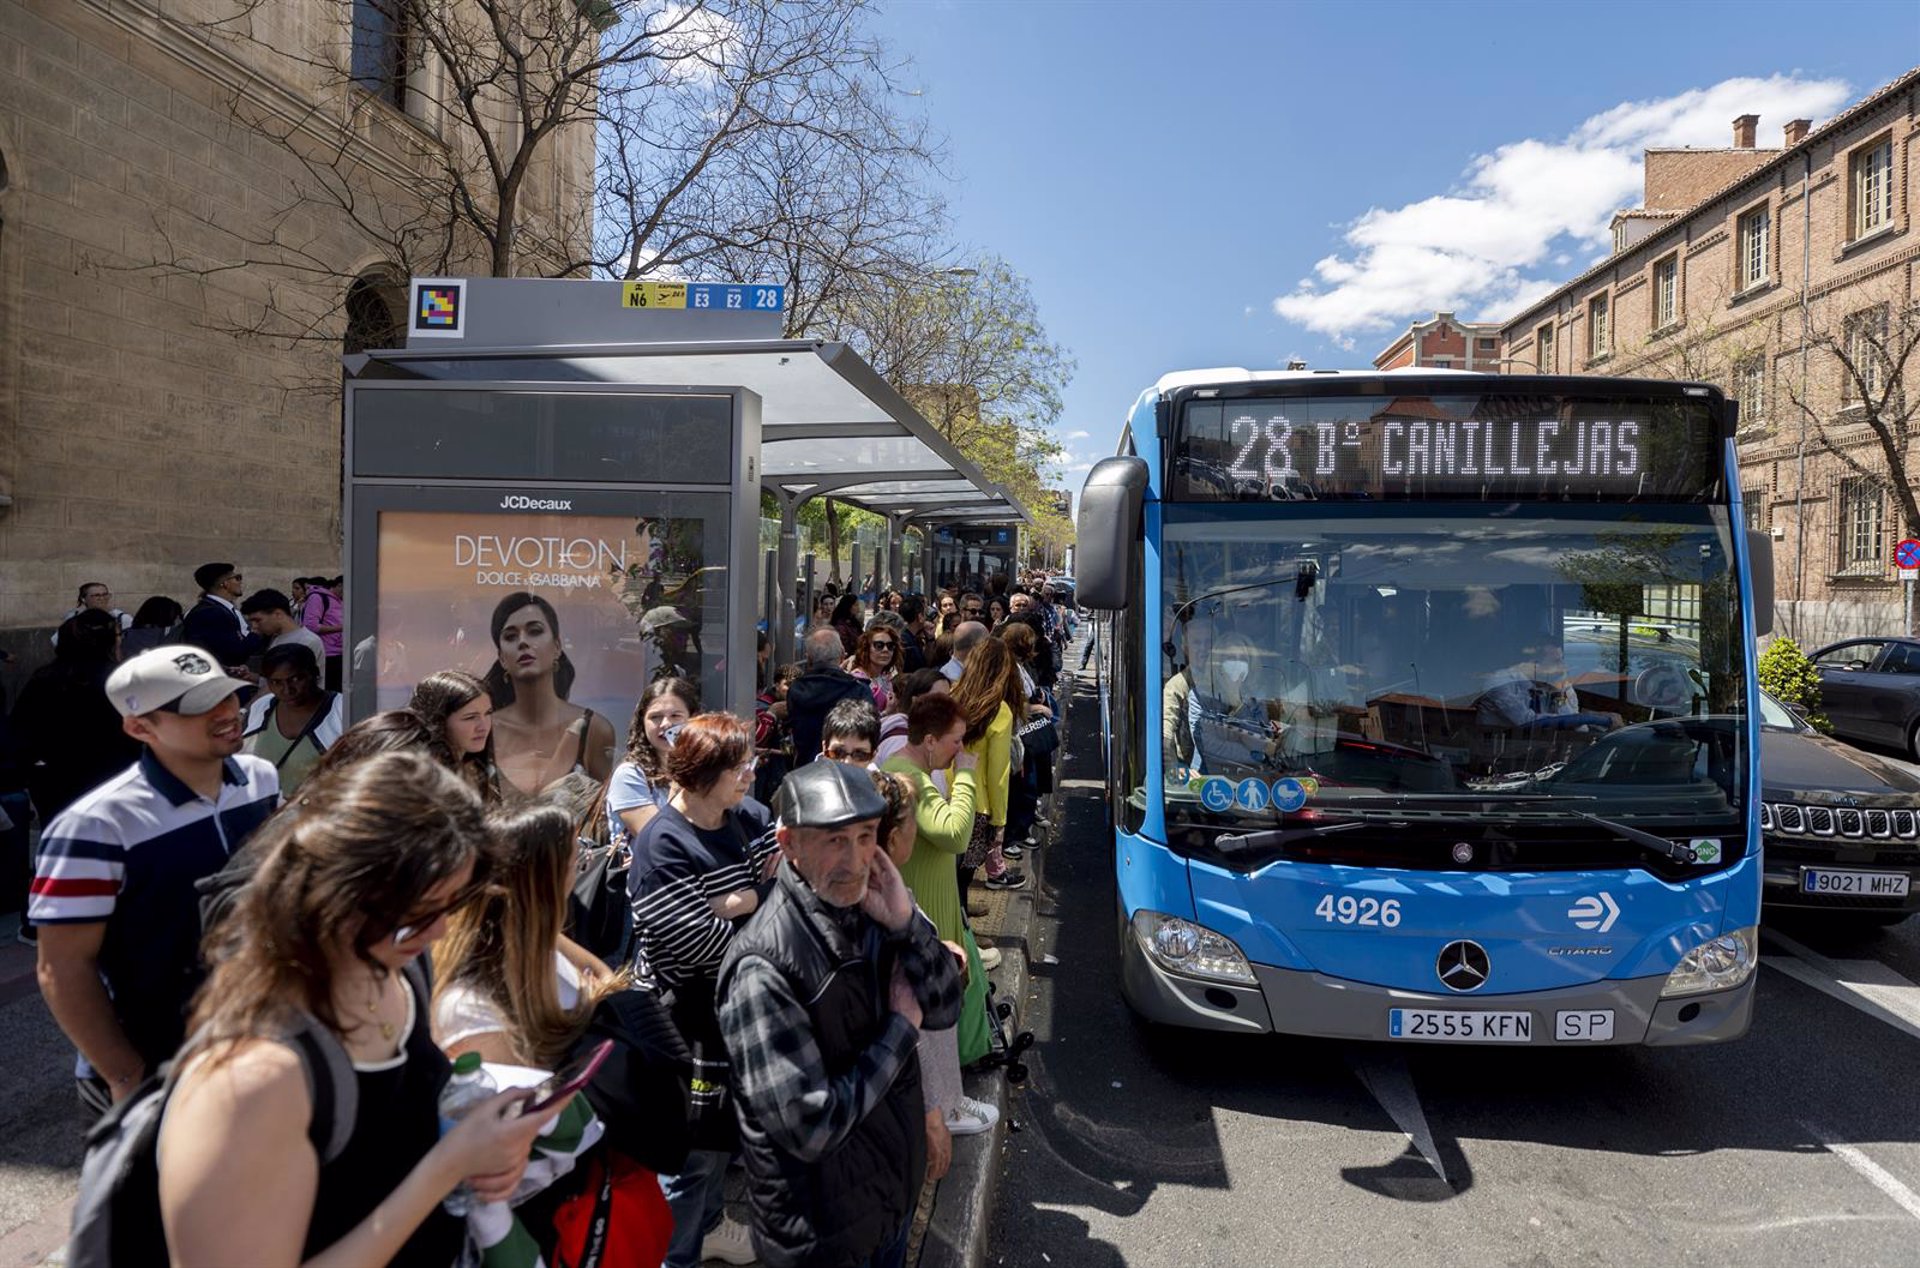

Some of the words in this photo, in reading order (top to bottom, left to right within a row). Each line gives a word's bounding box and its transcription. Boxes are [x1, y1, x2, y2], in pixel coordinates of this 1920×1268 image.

[629, 293, 647, 307] N6
[694, 293, 710, 307] E3
[726, 294, 741, 308] E2
[756, 289, 777, 308] 28
[1230, 415, 1292, 478] 28
[1382, 420, 1639, 476] CANILLEJAS
[500, 495, 572, 511] JCDecaux
[455, 534, 626, 571] DEVOTION
[476, 571, 521, 586] DOLCE
[529, 572, 601, 588] GABBANA
[1696, 846, 1717, 857] GNC
[1819, 874, 1863, 892] 9021
[1871, 877, 1904, 894] MHZ
[1315, 894, 1401, 928] 4926
[1547, 946, 1613, 956] CITARO
[1410, 1013, 1474, 1037] 2555
[1483, 1015, 1531, 1037] KFN
[1564, 1014, 1607, 1037] SP
